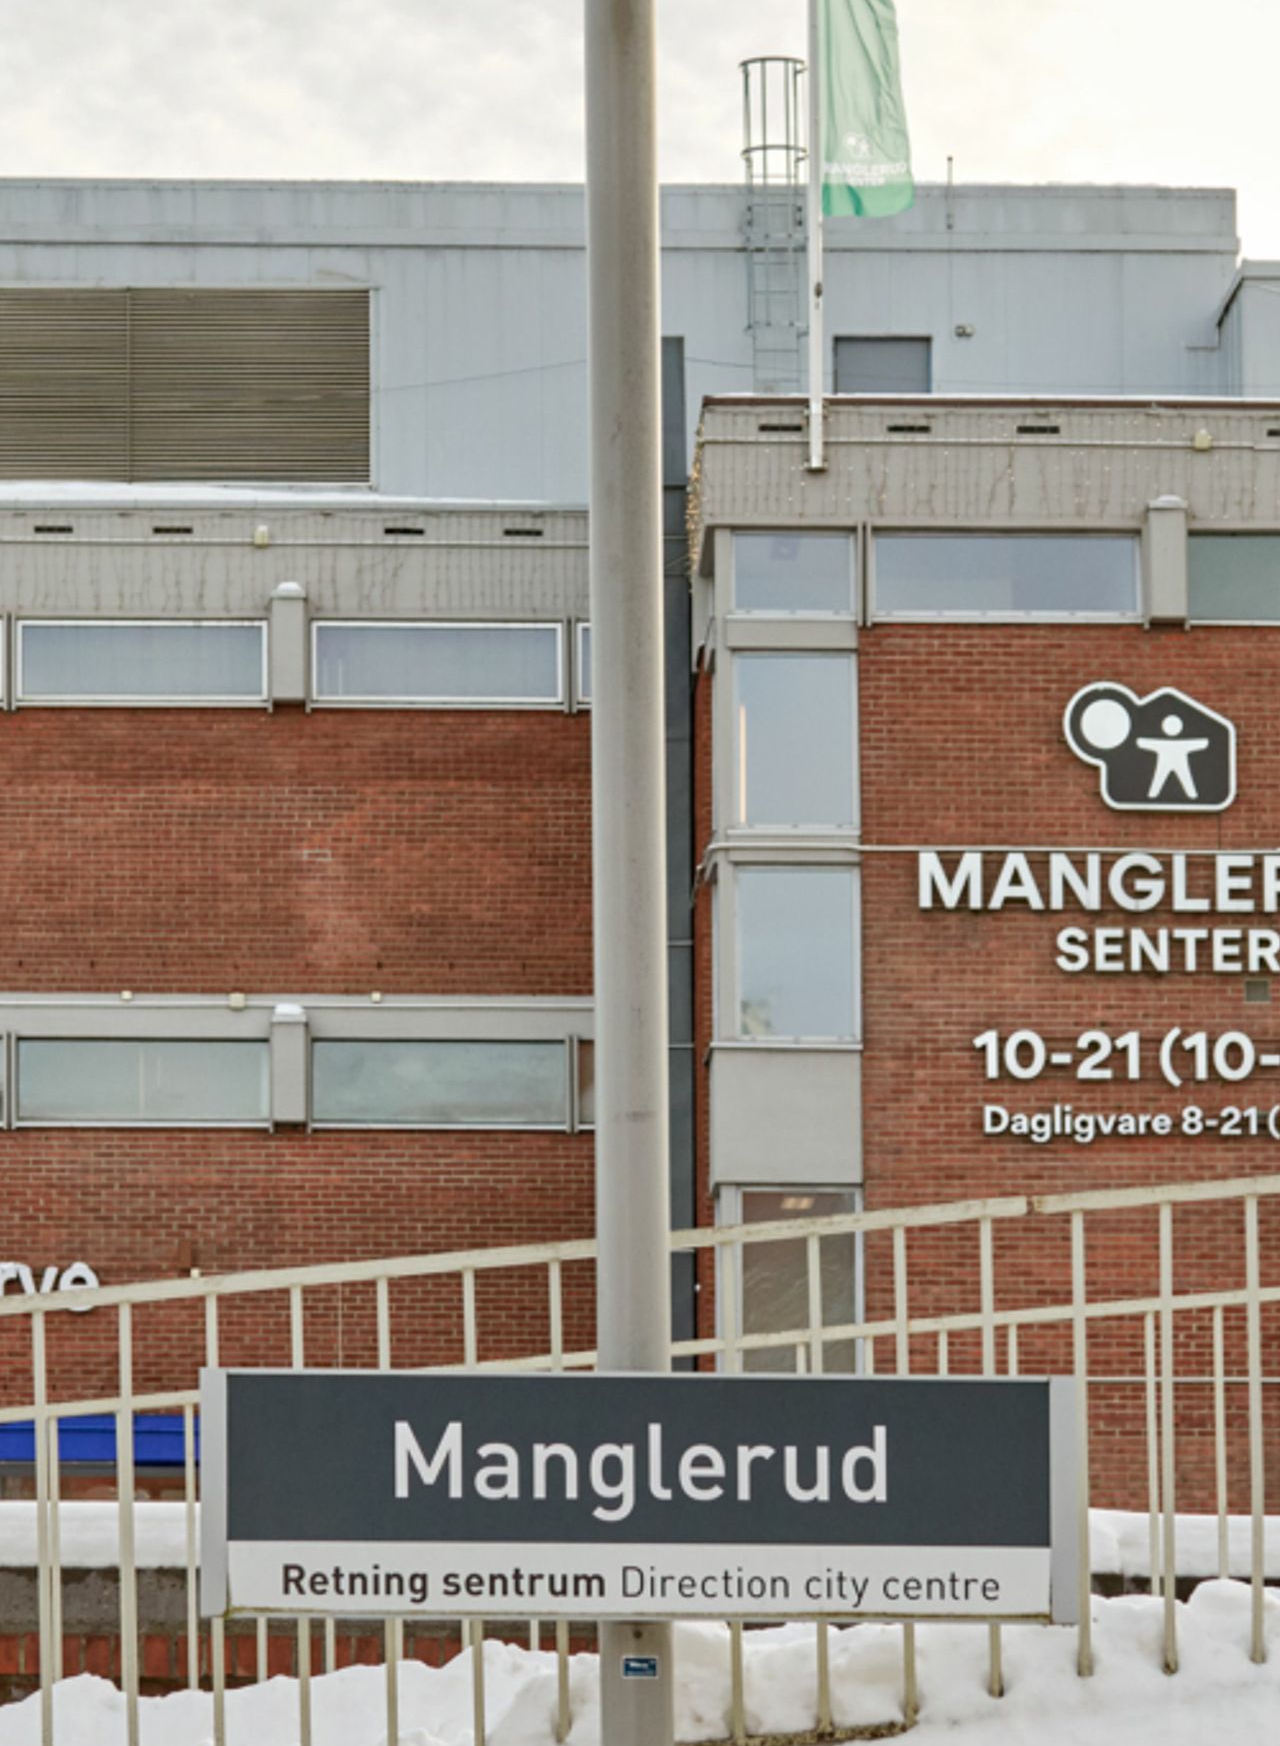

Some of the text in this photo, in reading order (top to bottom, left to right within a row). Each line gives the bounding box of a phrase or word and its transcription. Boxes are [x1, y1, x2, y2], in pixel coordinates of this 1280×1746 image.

[973, 1029, 1140, 1080] 10-21
[984, 1104, 1172, 1143] Dagligvare
[1182, 1105, 1258, 1136] 8-21
[394, 1421, 888, 1522] Manglerud
[282, 1563, 1000, 1608] Retning sentrum Direction city centre
